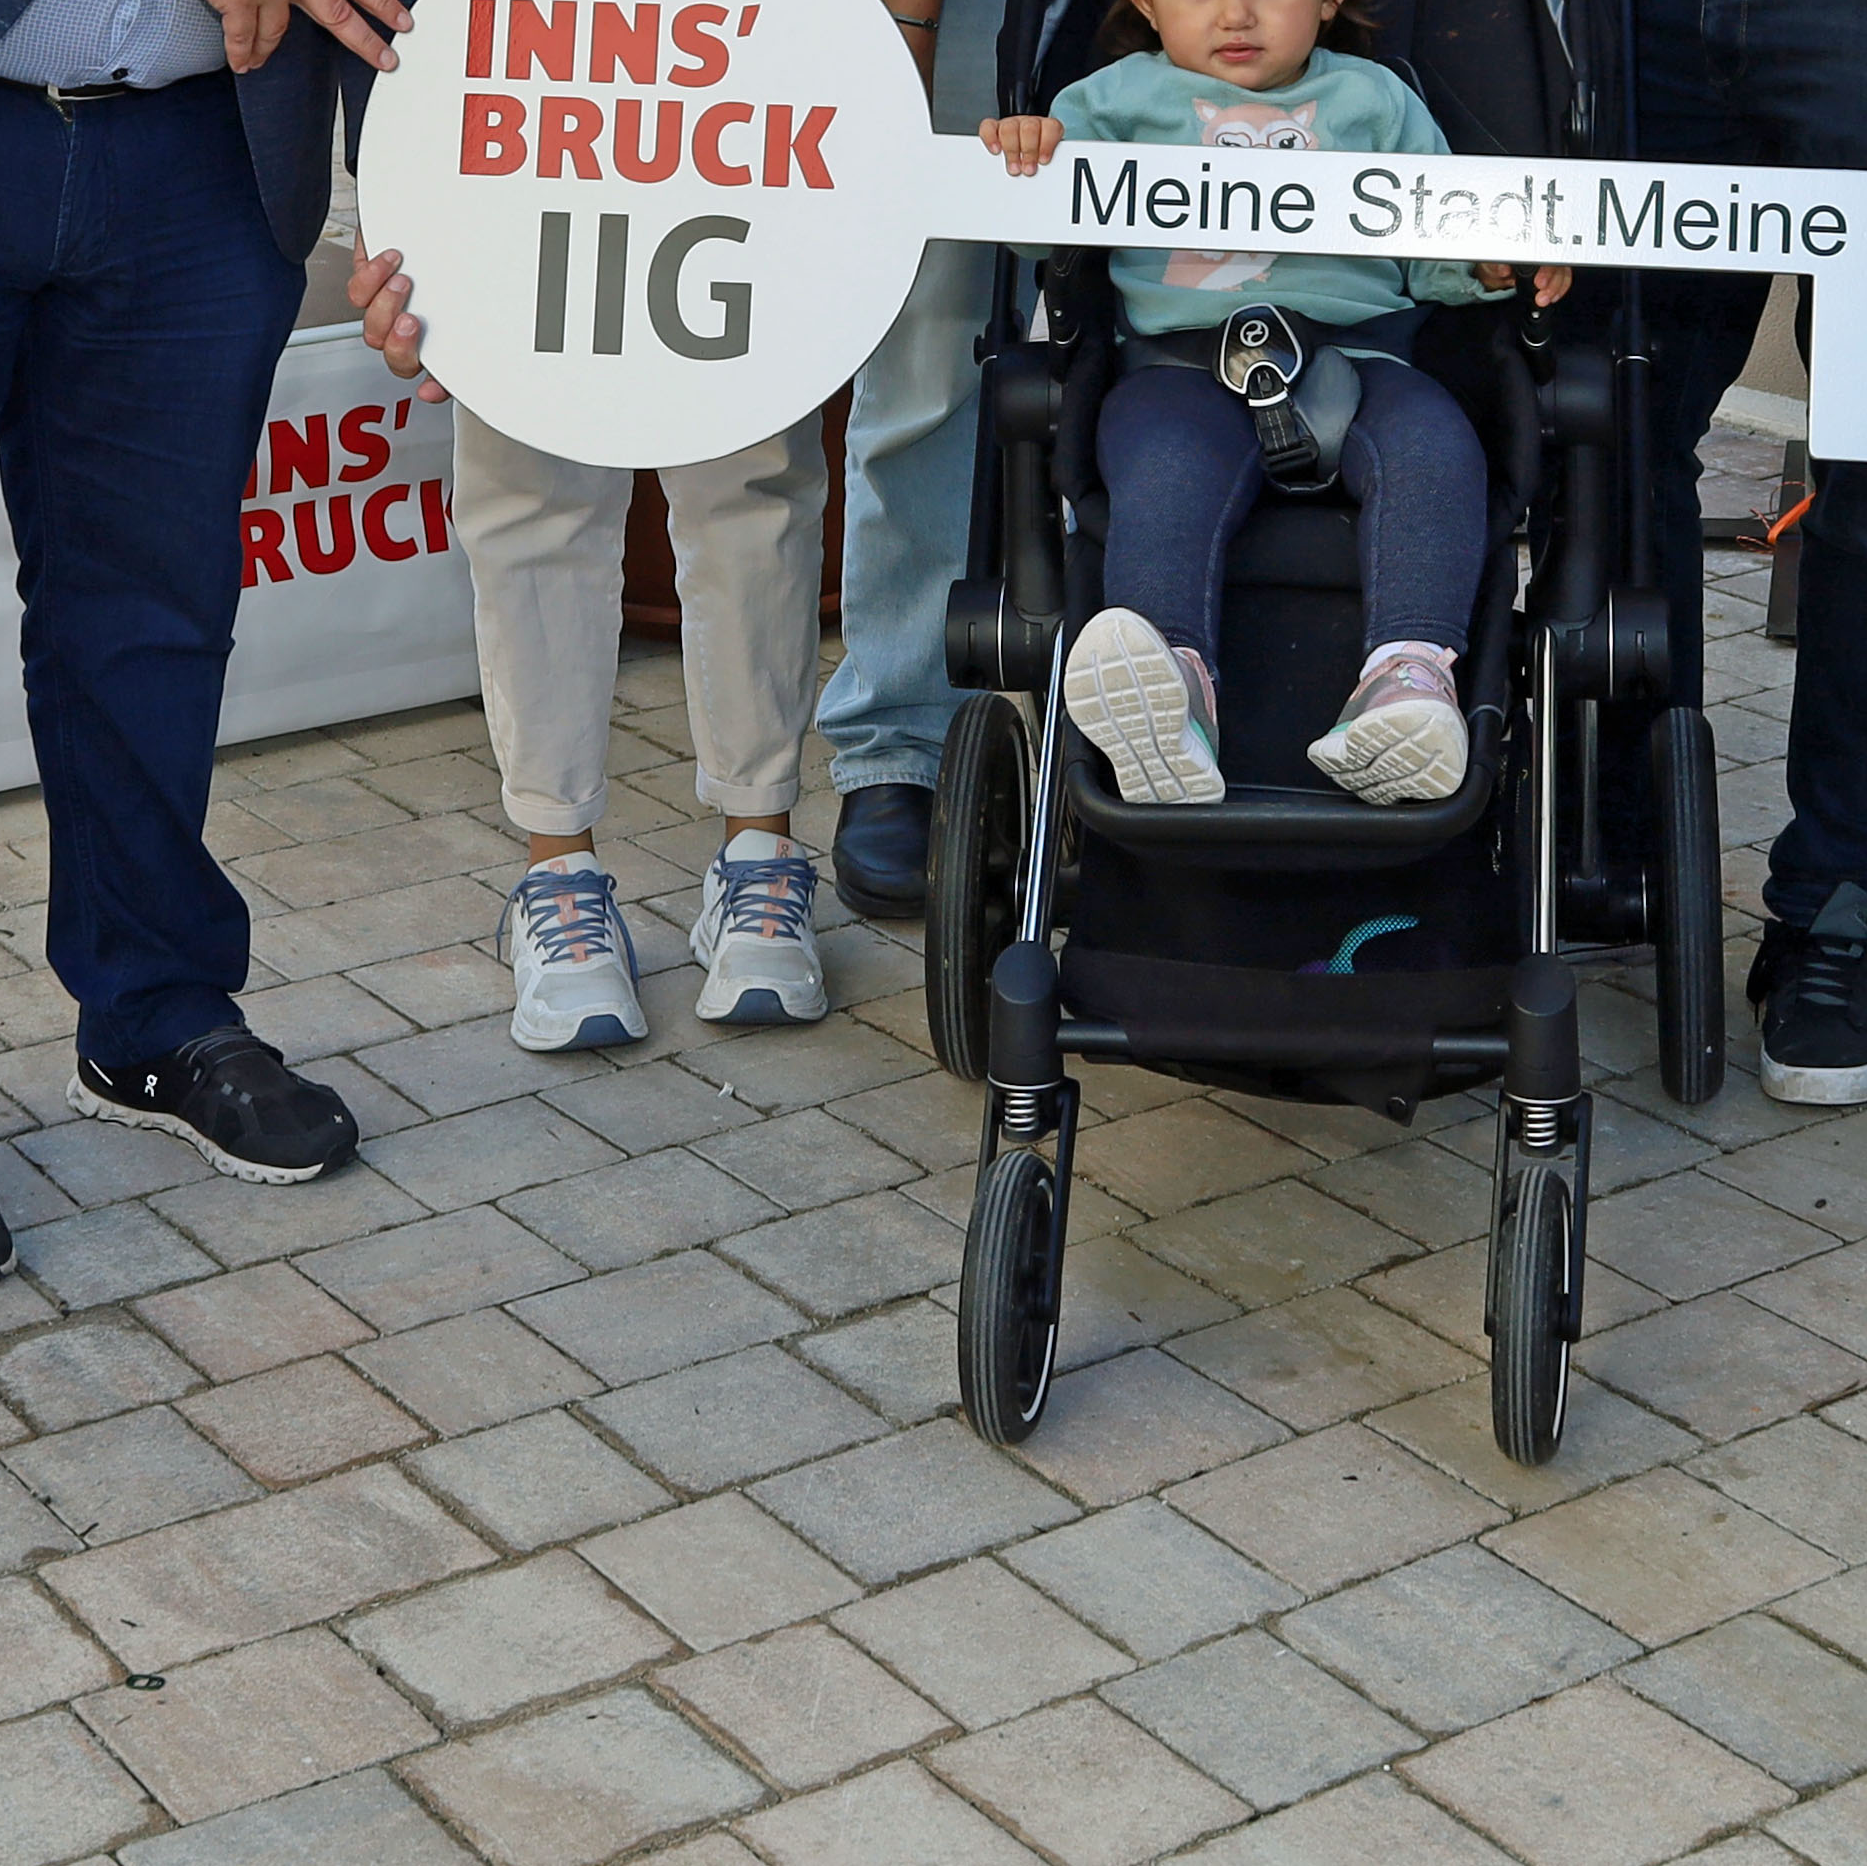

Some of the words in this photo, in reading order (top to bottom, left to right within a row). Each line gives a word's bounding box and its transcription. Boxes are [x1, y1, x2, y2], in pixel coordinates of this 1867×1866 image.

[459, 93, 838, 190] BRUCK
[1071, 157, 1315, 234] Meine
[534, 210, 753, 361] IIG
